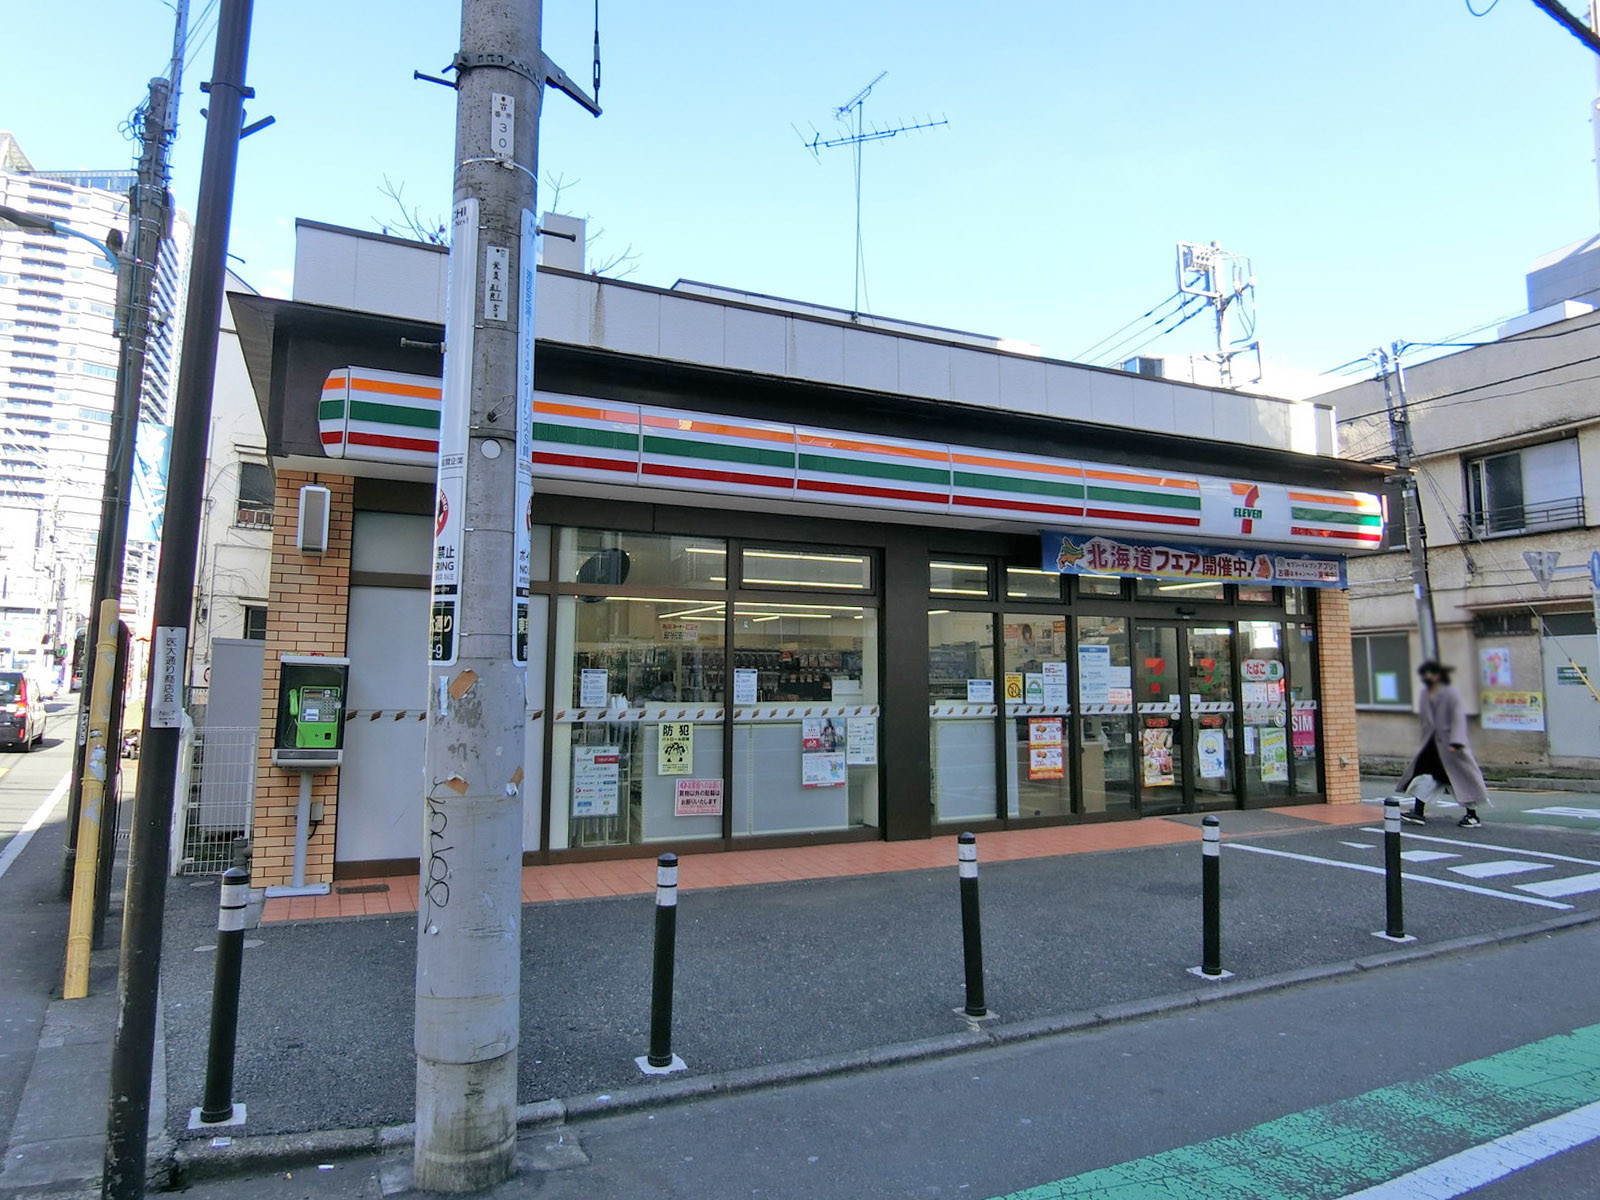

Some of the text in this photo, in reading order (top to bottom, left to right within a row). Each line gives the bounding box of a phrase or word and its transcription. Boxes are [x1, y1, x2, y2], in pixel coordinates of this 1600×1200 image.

[1230, 482, 1260, 535] 7
[1233, 507, 1263, 519] ELEVEN
[432, 615, 453, 632] 通り
[1246, 663, 1266, 675] たばこ
[662, 724, 690, 737] 防犯
[1291, 714, 1313, 732] SIM
